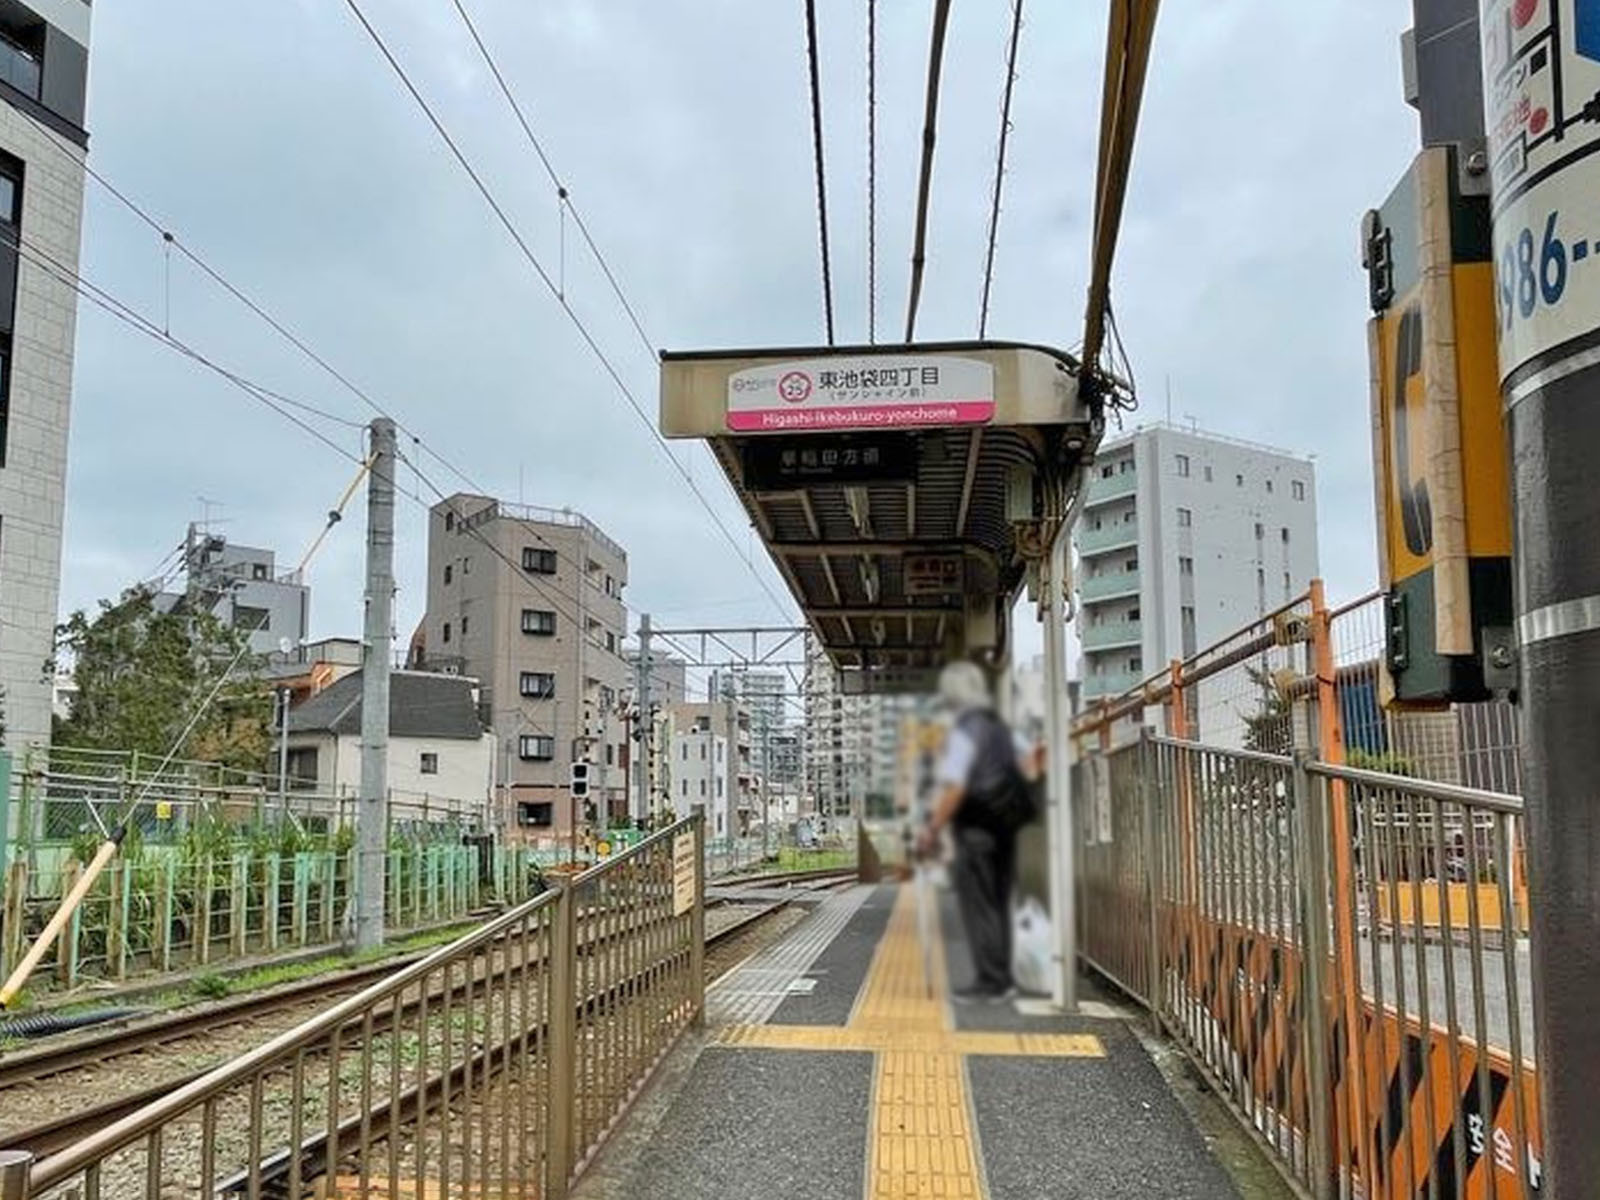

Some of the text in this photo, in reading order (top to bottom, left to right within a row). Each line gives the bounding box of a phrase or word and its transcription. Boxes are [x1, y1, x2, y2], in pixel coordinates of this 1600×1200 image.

[818, 366, 939, 390] 東池袋四丁目
[786, 384, 804, 396] 25
